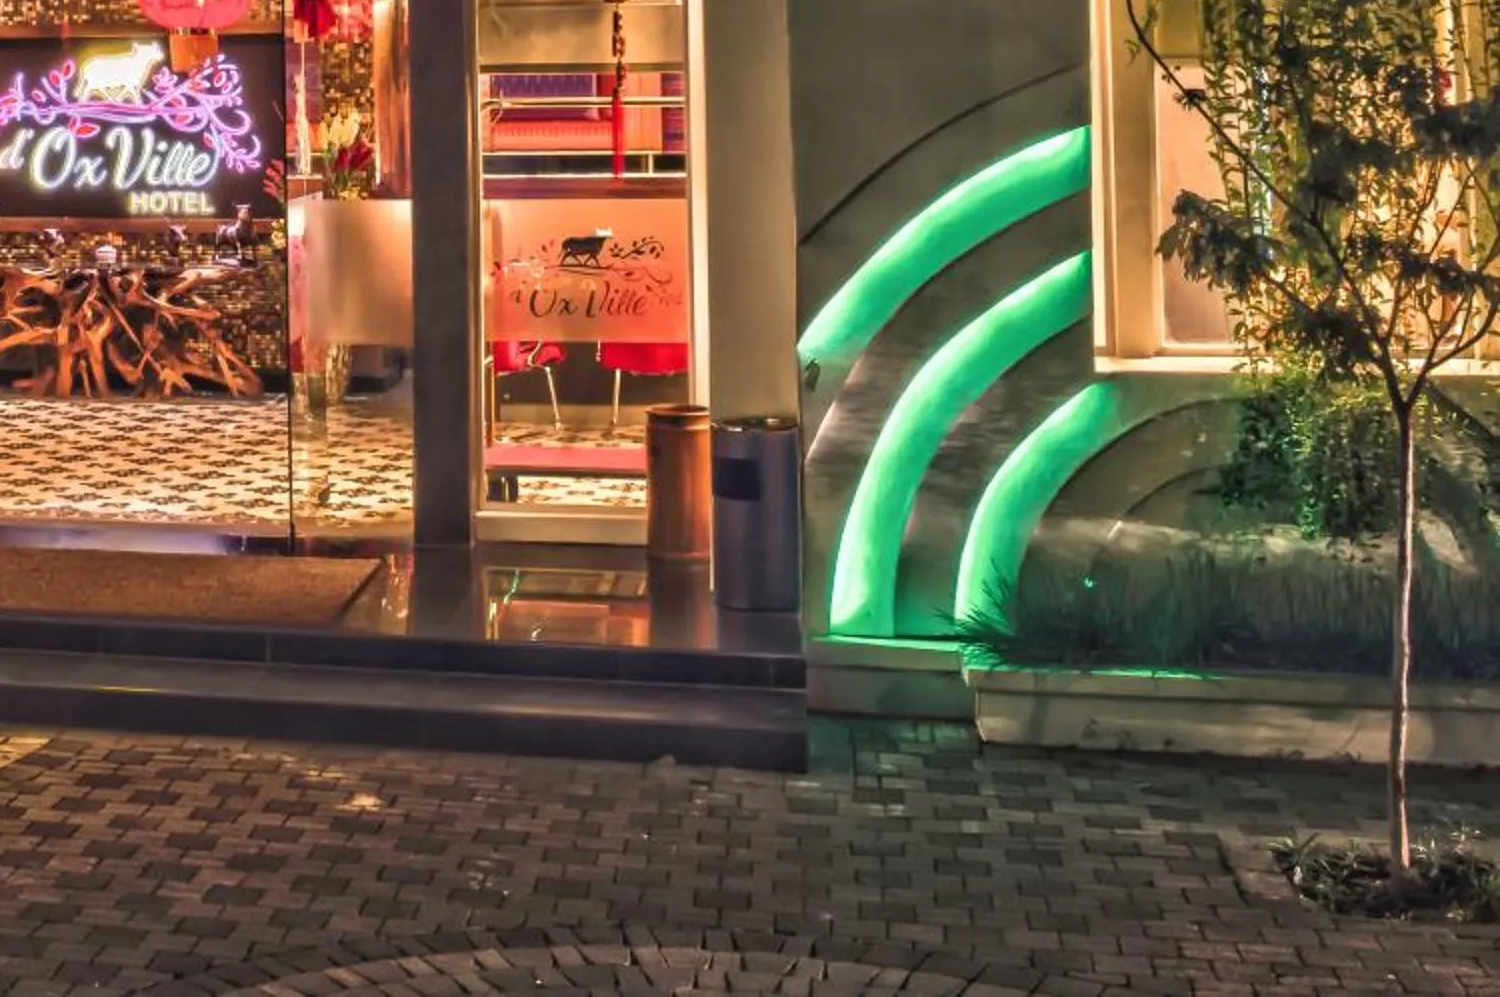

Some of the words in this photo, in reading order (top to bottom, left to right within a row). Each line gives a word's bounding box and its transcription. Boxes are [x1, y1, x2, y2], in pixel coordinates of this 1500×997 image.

[105, 126, 218, 189] Ville
[130, 191, 215, 215] HOTEL
[580, 278, 647, 318] Ville
